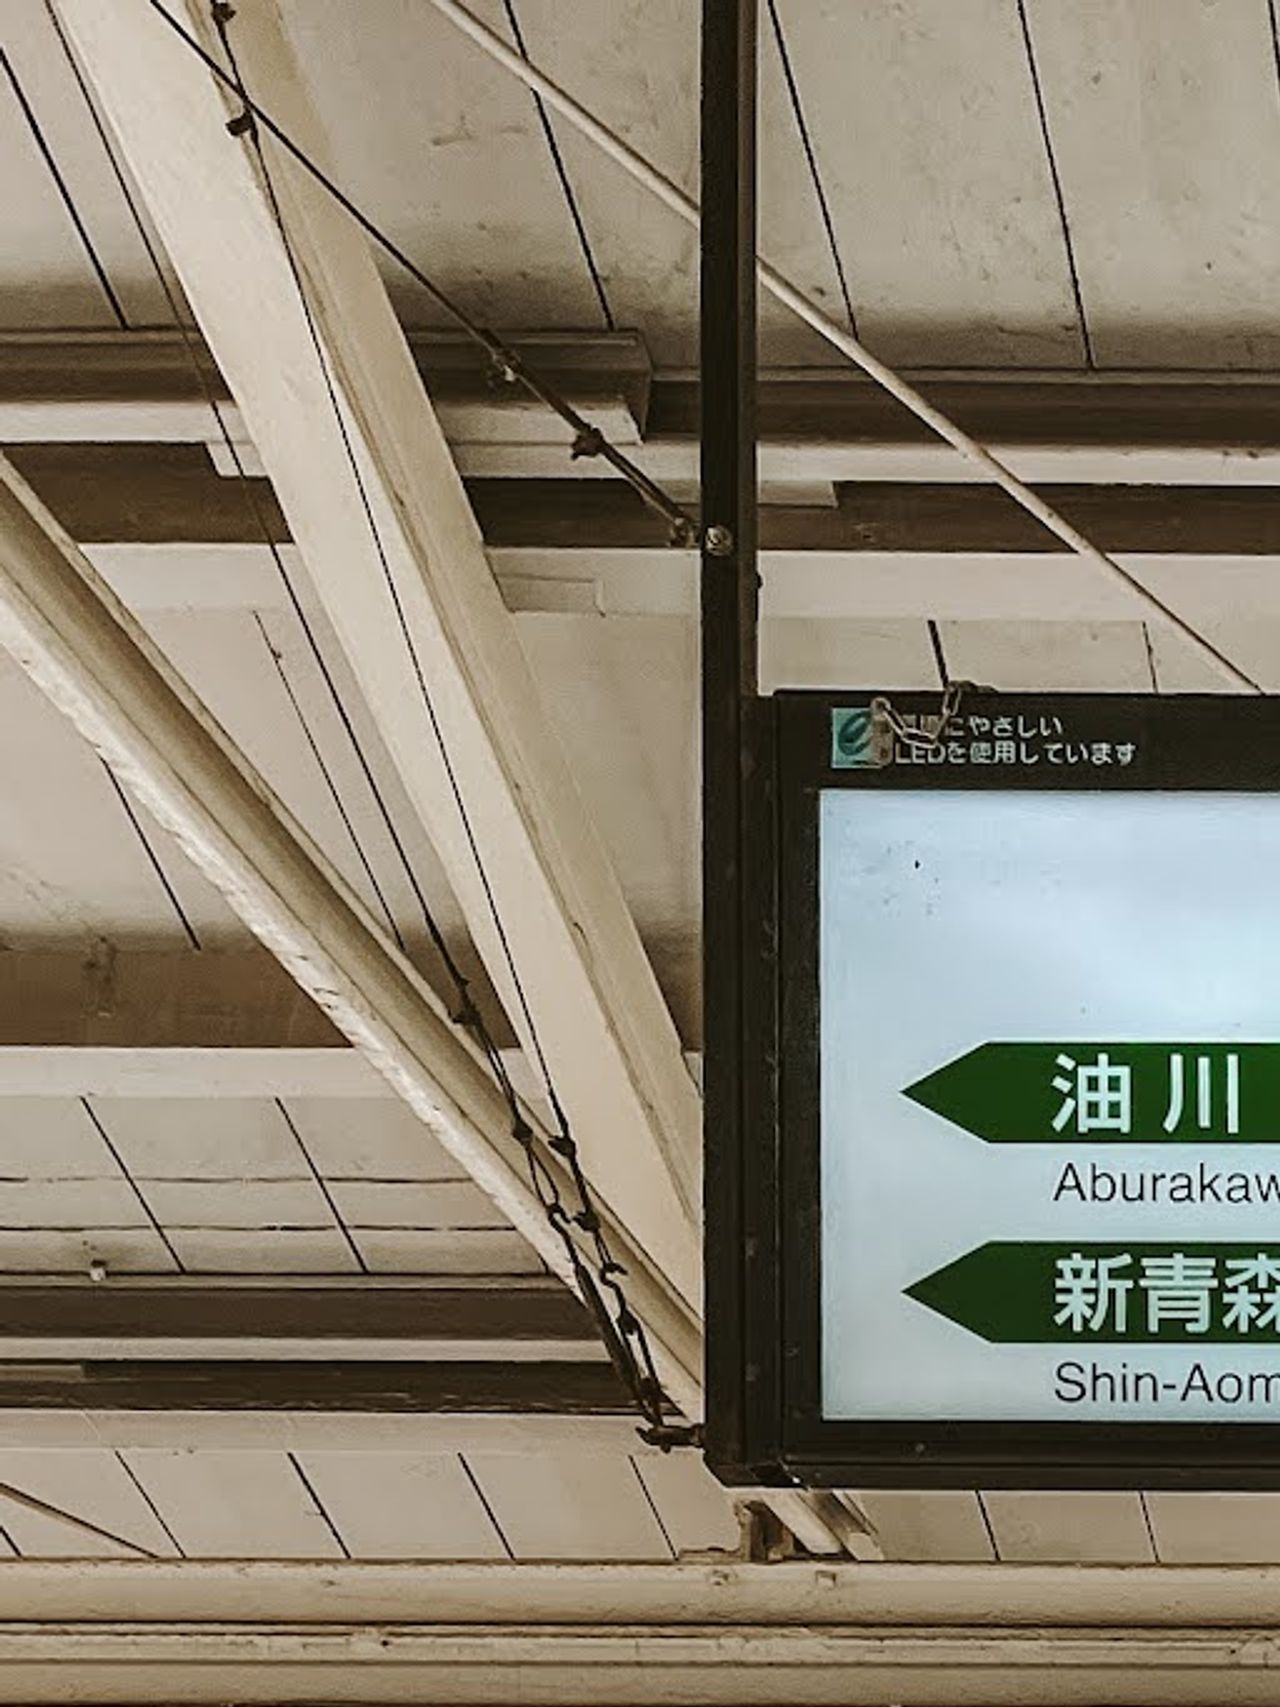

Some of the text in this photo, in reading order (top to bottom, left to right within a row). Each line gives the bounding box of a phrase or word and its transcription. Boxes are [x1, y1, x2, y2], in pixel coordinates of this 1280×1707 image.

[894, 742, 1136, 765] LEDを使用しています
[1050, 1054, 1241, 1134] 油川
